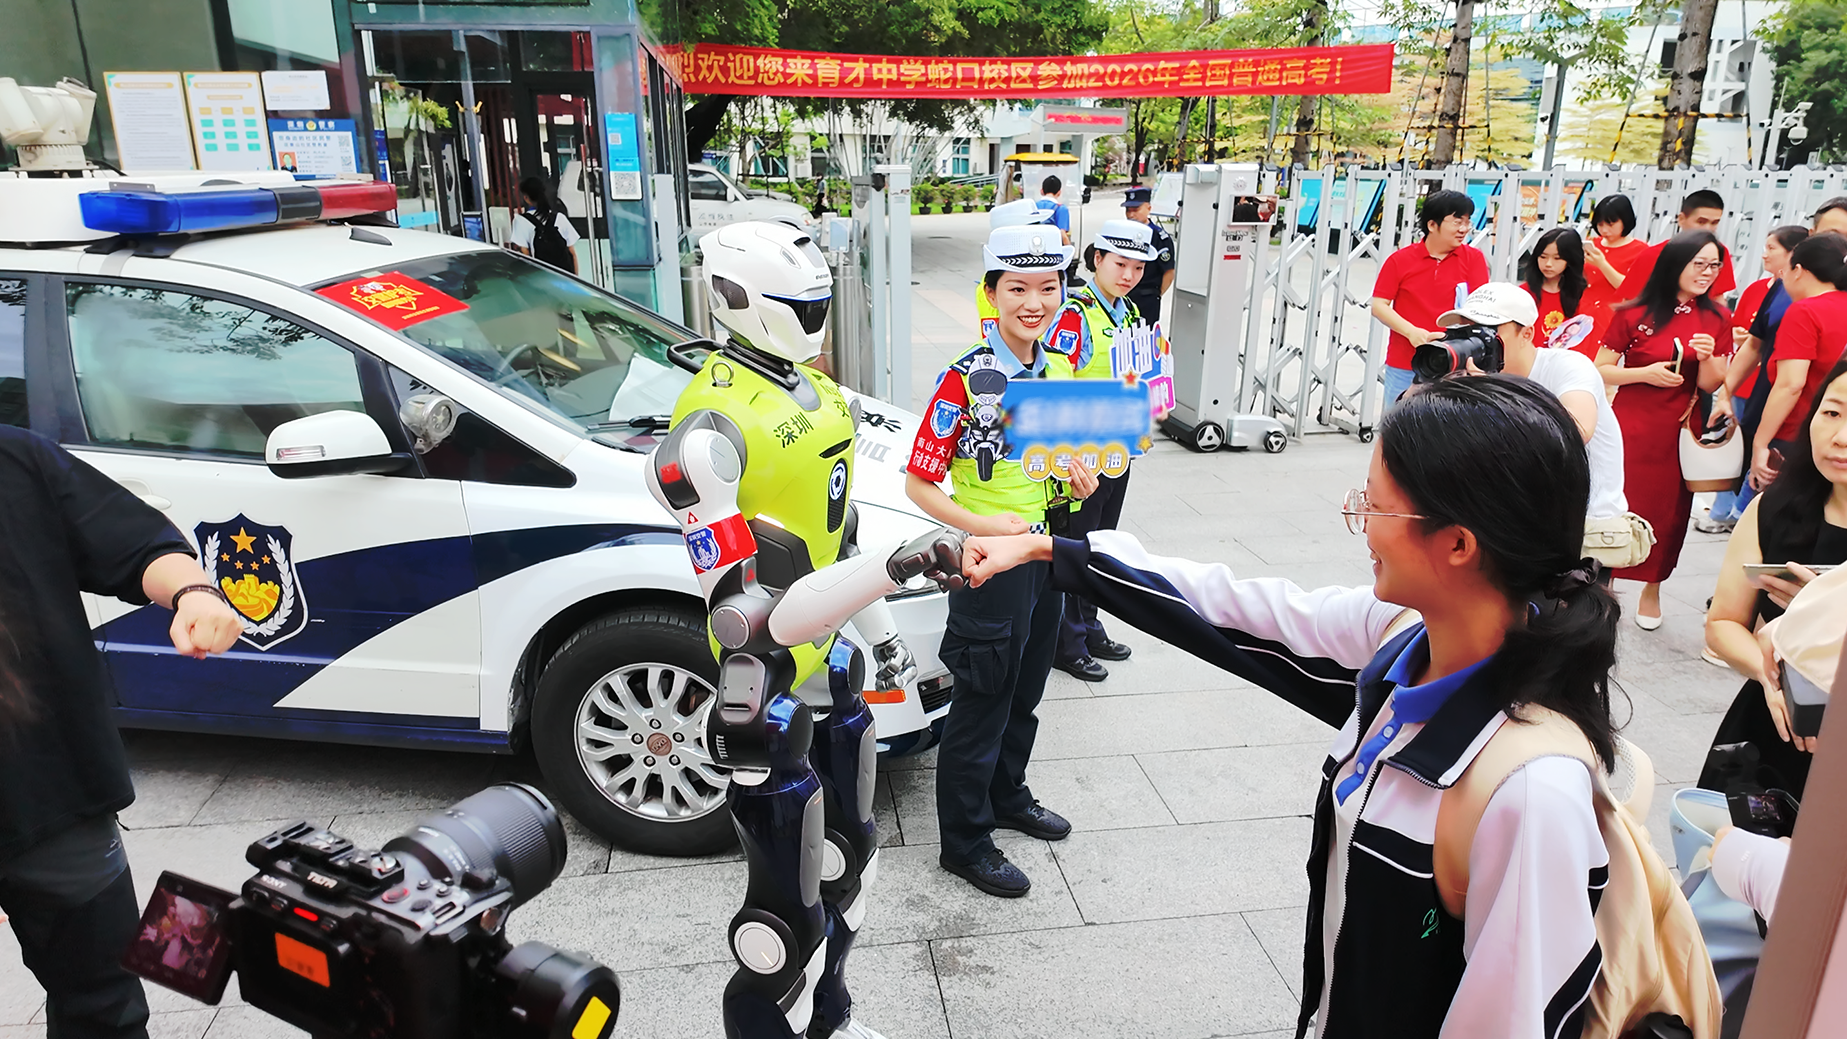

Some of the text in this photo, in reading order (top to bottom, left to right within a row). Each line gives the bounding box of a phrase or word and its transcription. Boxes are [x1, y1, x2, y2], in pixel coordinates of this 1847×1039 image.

[773, 411, 814, 448] 深圳
[1028, 453, 1123, 473] 高考加油
